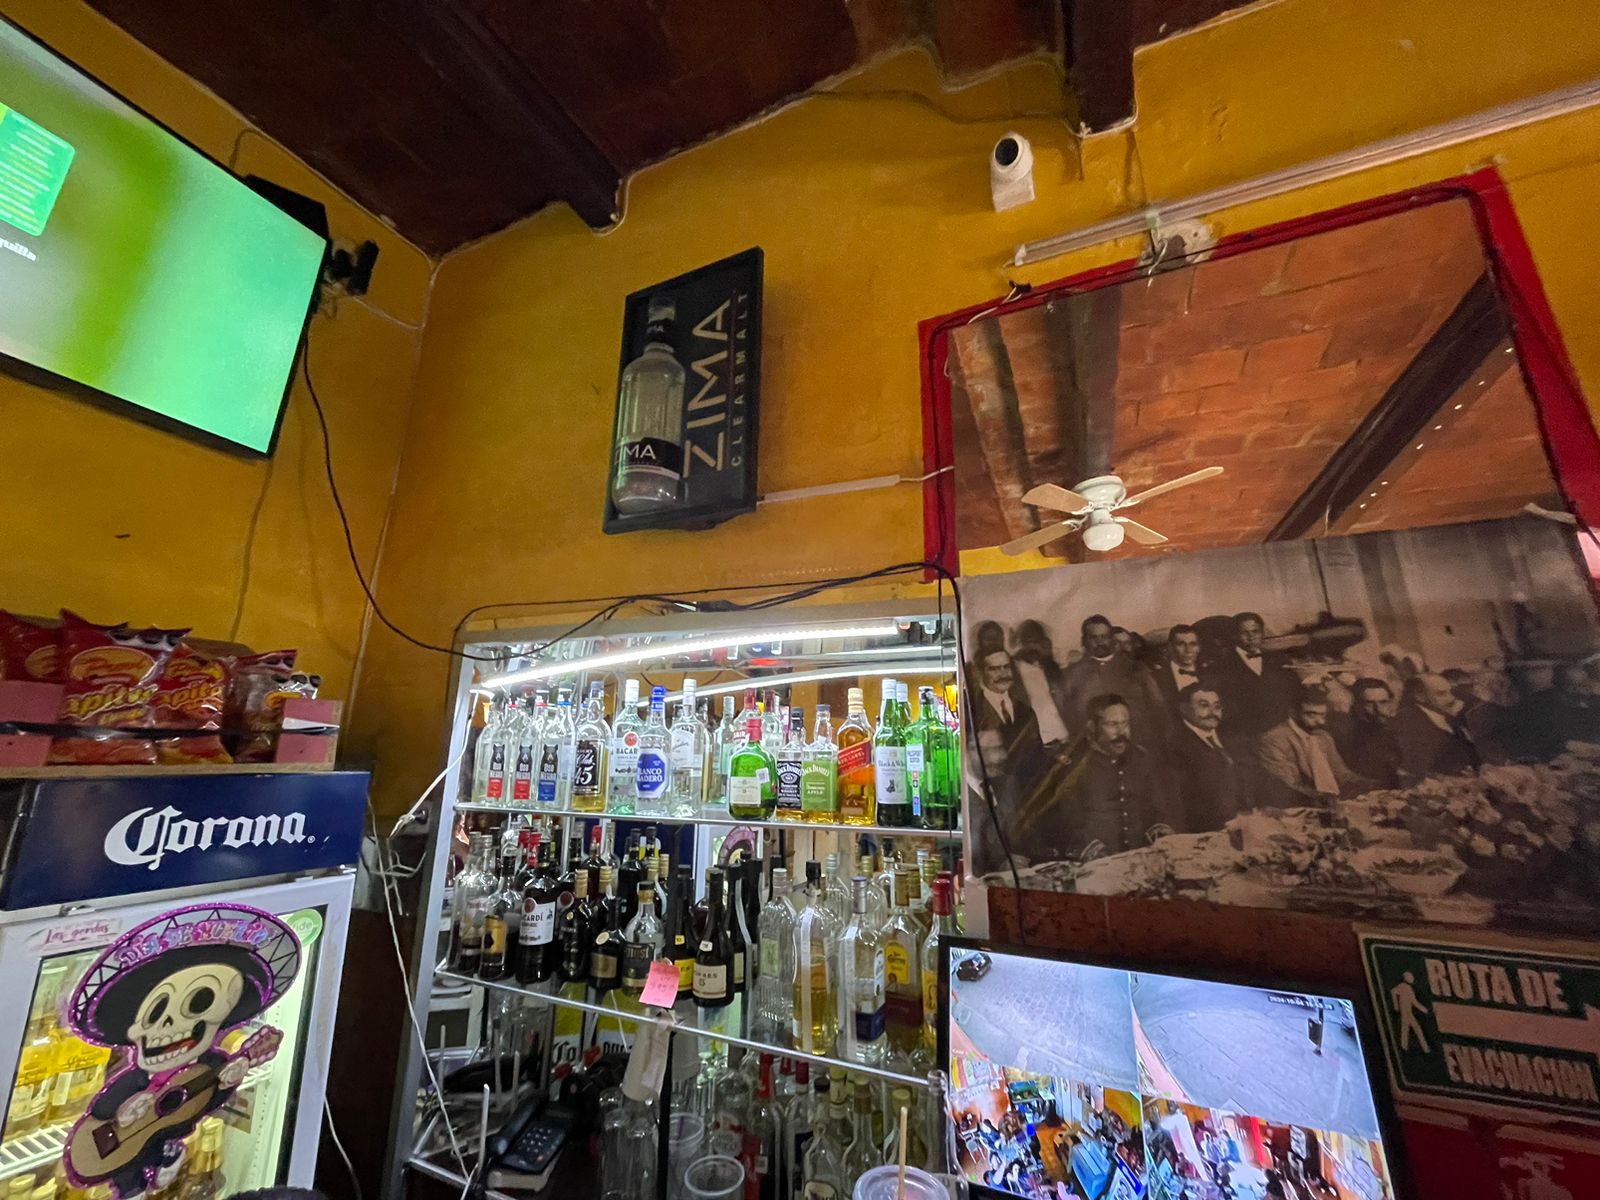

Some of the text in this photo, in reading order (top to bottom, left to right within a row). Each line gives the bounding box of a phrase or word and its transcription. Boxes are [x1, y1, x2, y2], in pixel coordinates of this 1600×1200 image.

[683, 299, 731, 478] ZIMA
[104, 806, 306, 870] Corona
[1425, 957, 1568, 1011] RUTA DE
